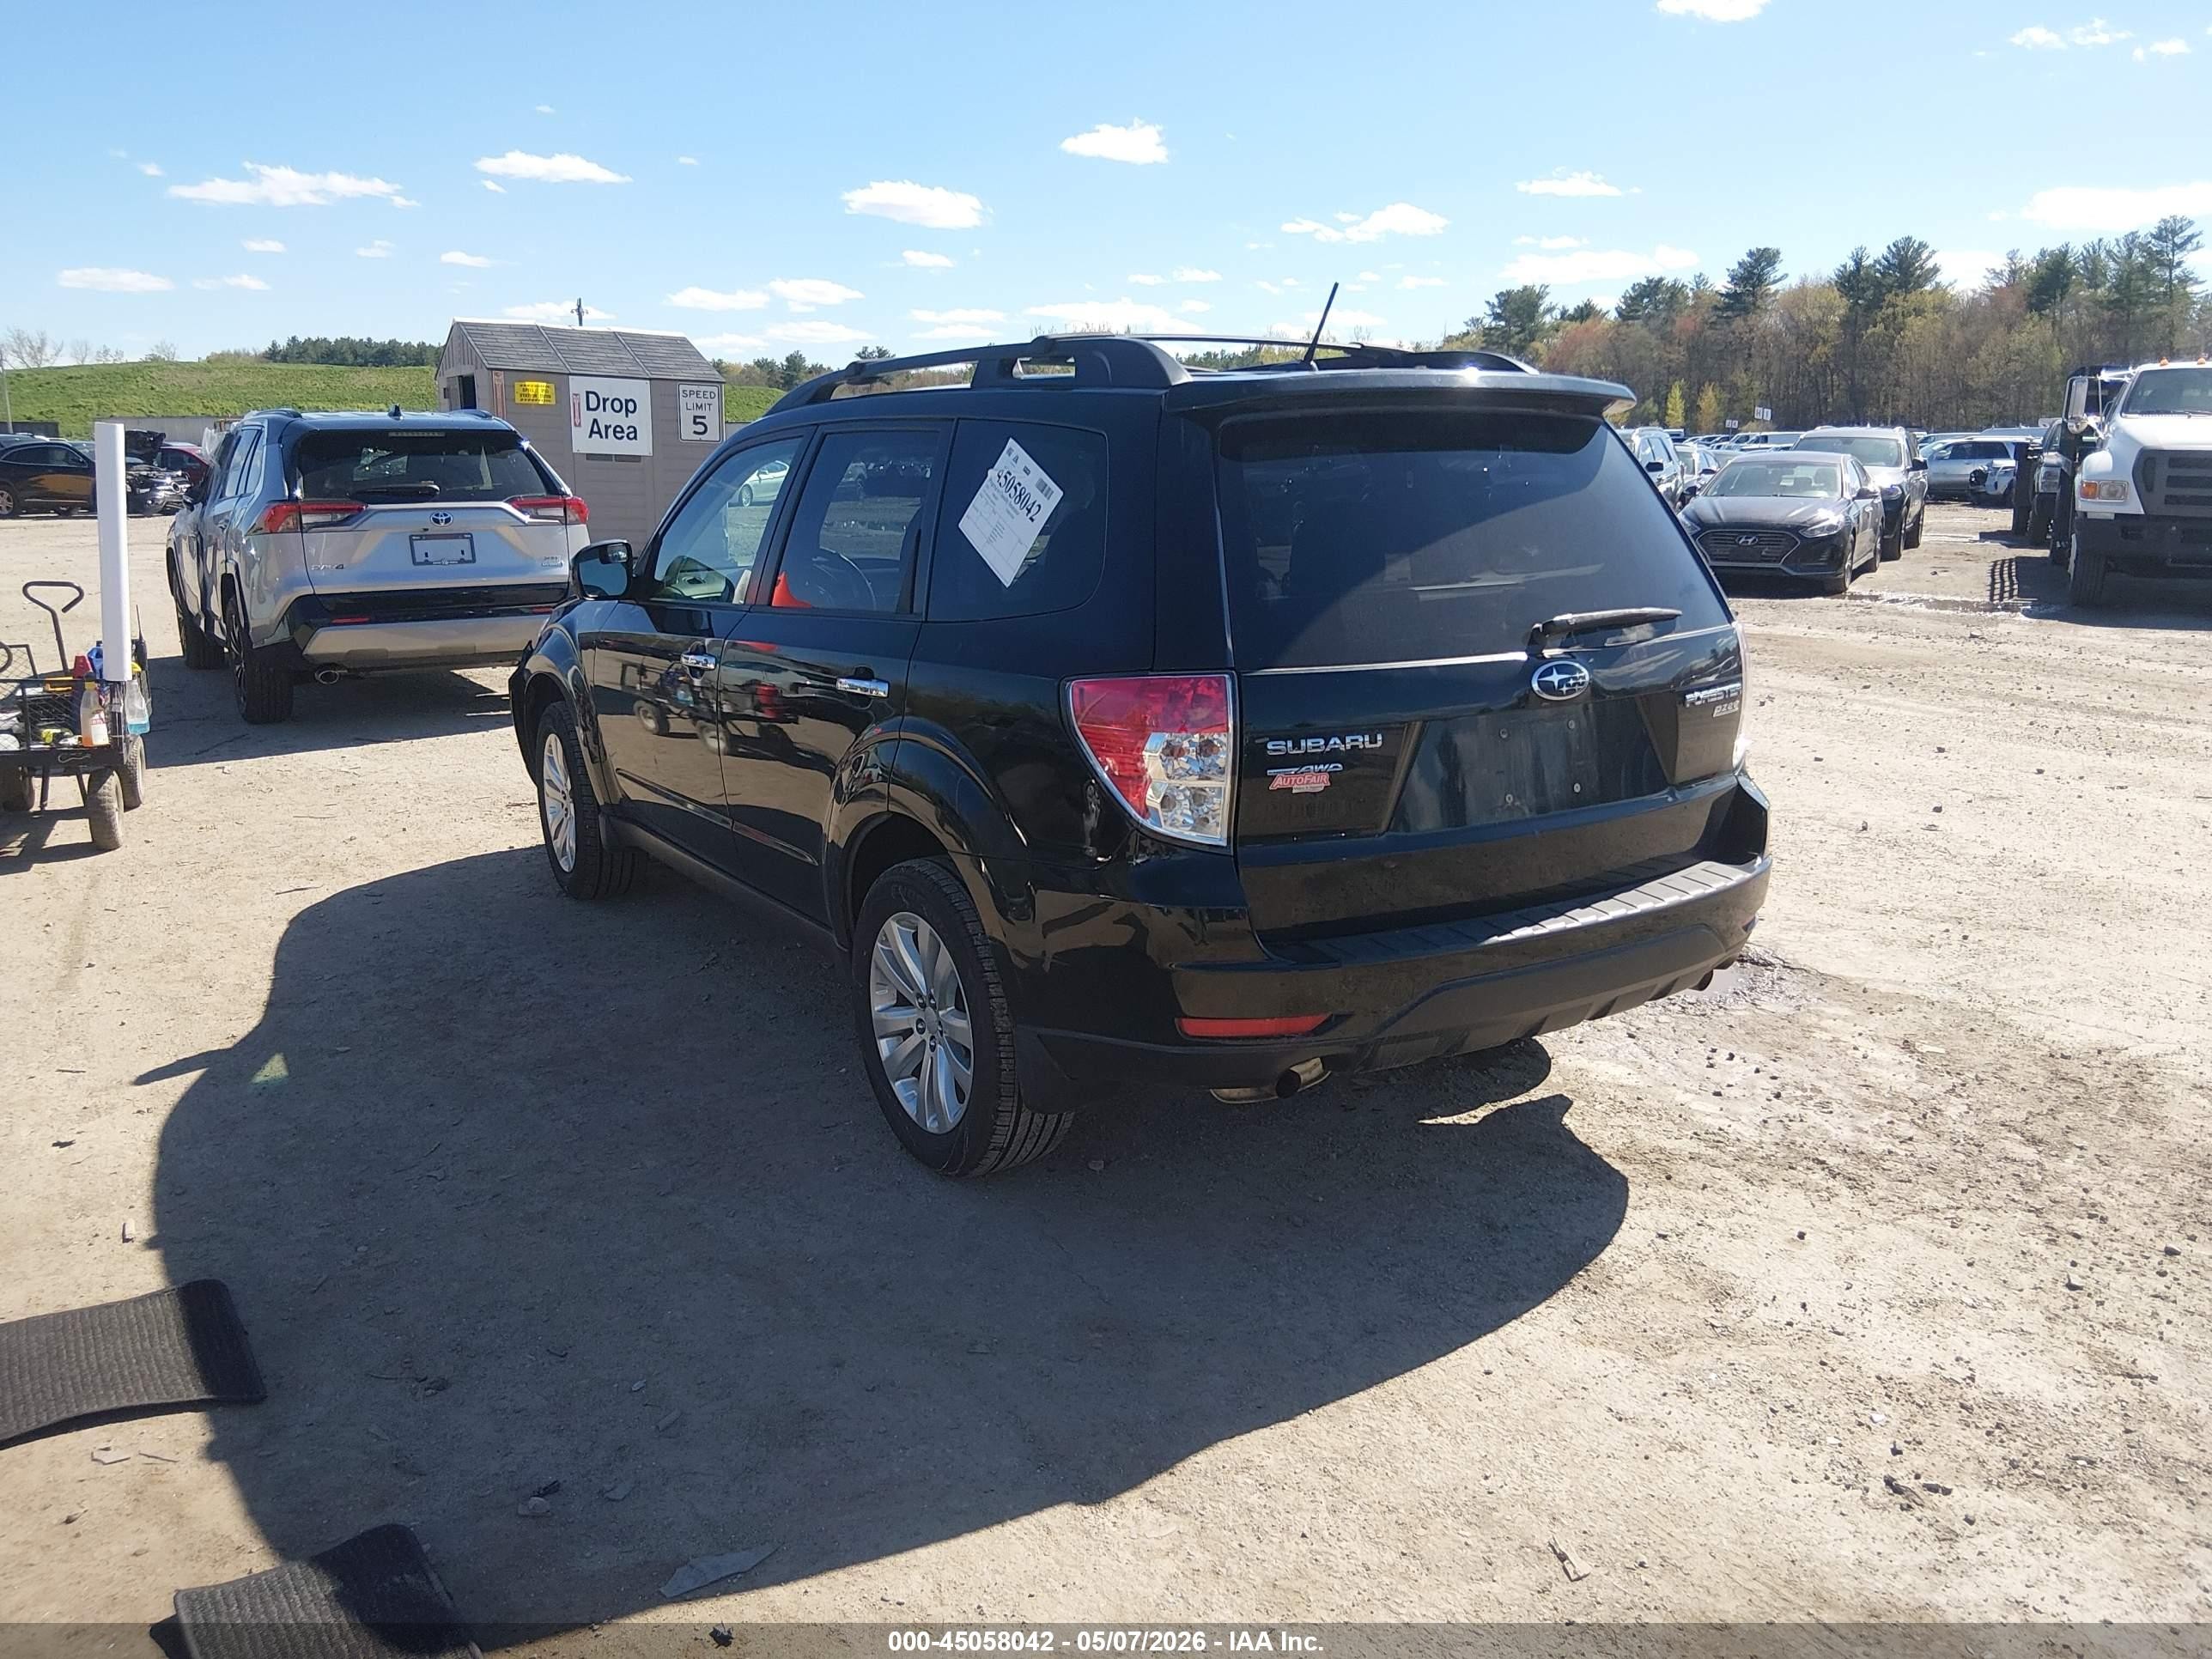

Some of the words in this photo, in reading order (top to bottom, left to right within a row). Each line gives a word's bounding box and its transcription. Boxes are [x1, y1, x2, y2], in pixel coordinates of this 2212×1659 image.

[586, 391, 638, 417] Drop
[682, 389, 716, 400] SPEED
[685, 401, 712, 412] LIMIT
[588, 417, 638, 441] Area
[692, 416, 708, 435] 5
[997, 469, 1042, 523] 45058042
[1267, 733, 1382, 756] SUBARU
[1297, 763, 1344, 775] AWD
